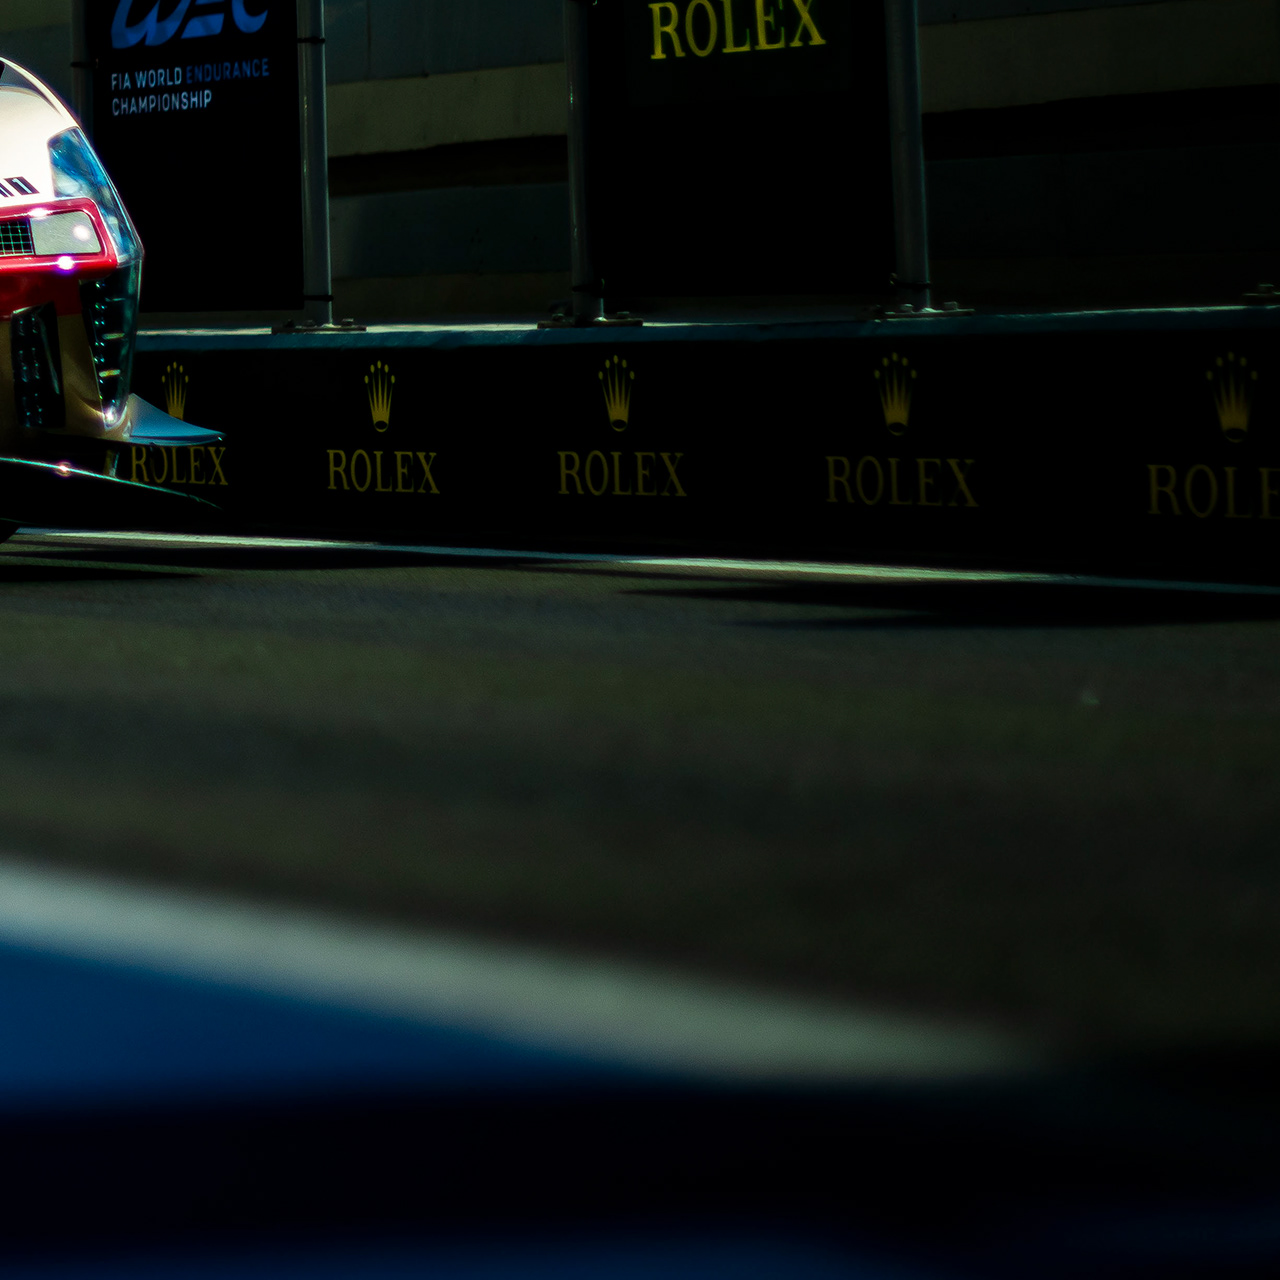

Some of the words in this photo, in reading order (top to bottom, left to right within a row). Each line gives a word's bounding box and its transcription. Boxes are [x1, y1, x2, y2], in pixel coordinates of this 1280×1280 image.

[111, 73, 131, 91] FIA
[135, 67, 183, 89] WORLD
[185, 57, 270, 85] ENDURANCE
[111, 89, 213, 117] CHAMPIONSHIP
[129, 445, 229, 486] ROLEX
[326, 448, 441, 495] ROLEX
[556, 449, 688, 497] ROLEX
[824, 454, 980, 508] ROLEX
